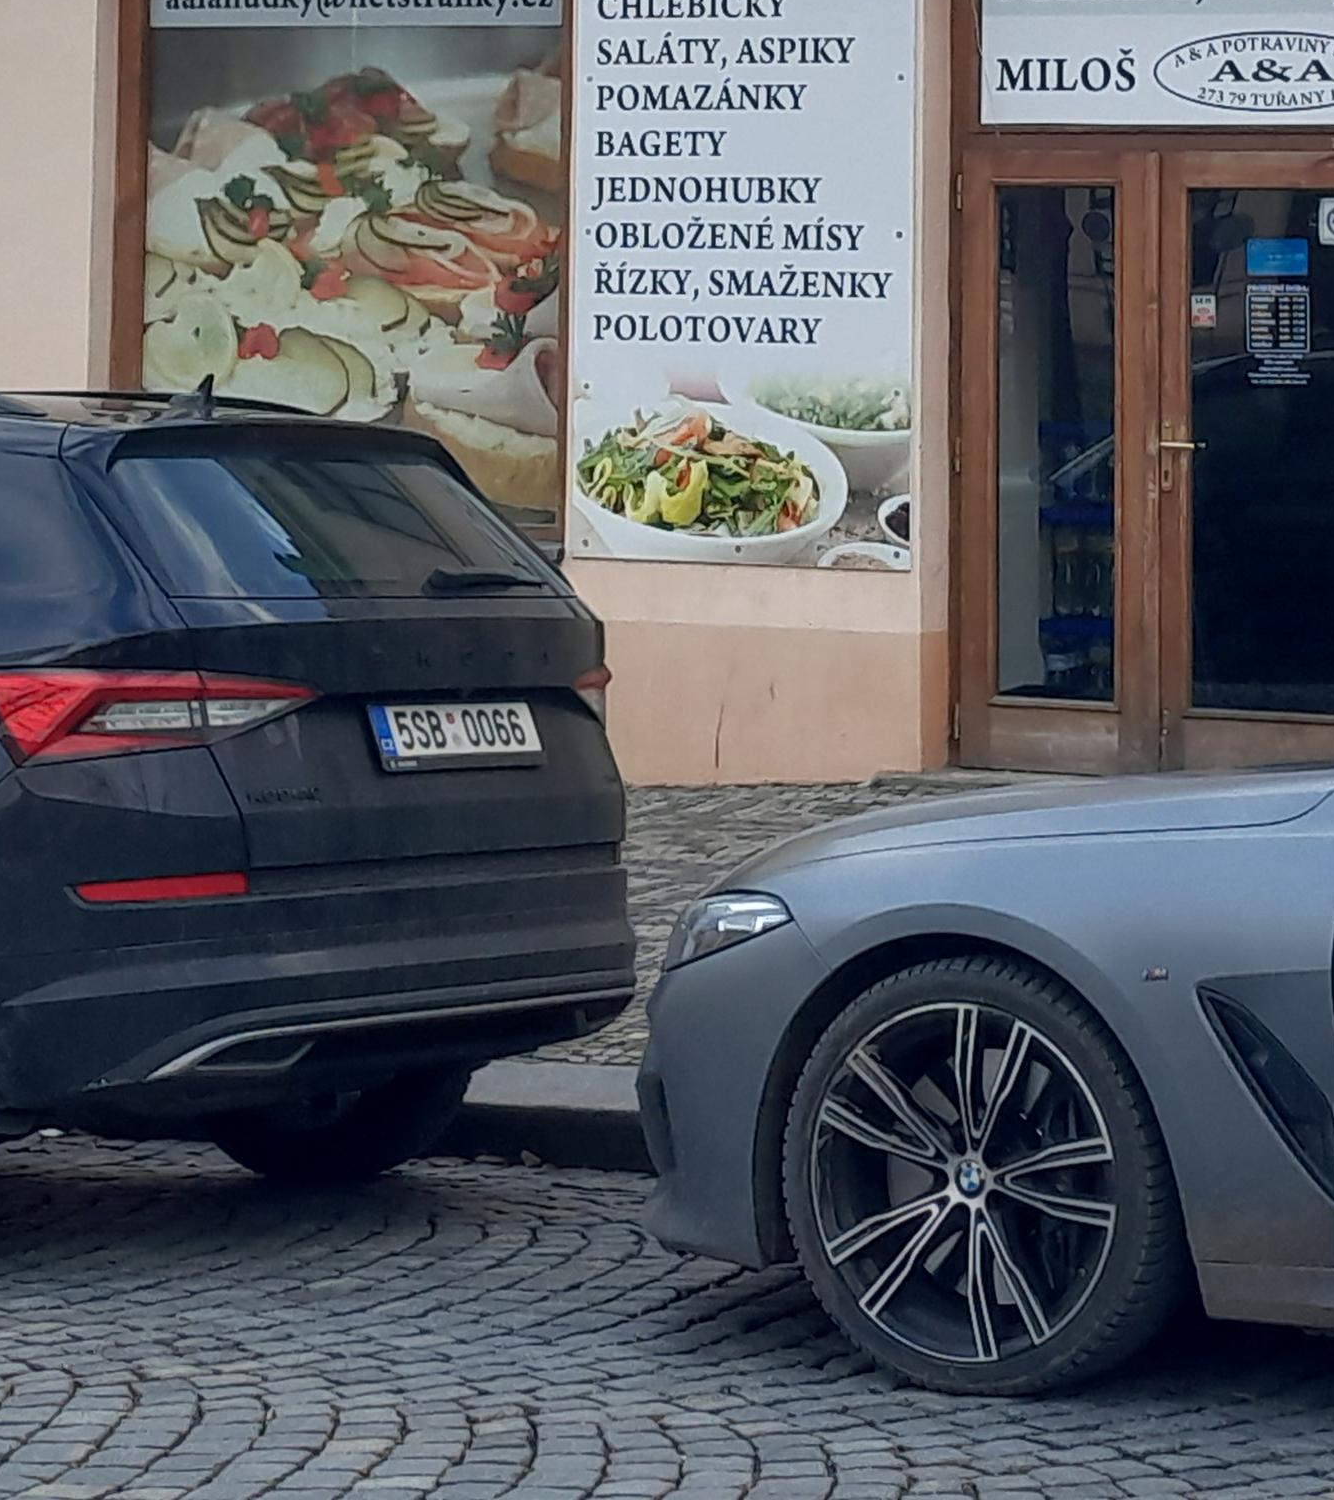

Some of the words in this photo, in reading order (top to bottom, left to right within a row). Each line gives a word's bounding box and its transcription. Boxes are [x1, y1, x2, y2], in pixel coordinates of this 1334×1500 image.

[596, 32, 728, 69] SALÁTY,
[736, 37, 856, 64] ASPIKY
[1174, 54, 1186, 68] A
[1189, 49, 1202, 62] &
[1206, 43, 1219, 56] A
[1223, 37, 1331, 54] POTRAVINY
[996, 48, 1136, 92] MILOŠ
[596, 77, 808, 111] POMAZÁNKY
[1197, 87, 1224, 103] 273
[1229, 92, 1247, 105] 79
[1250, 88, 1325, 107] TUŘANY
[595, 130, 727, 157] BAGETY
[592, 176, 822, 210] JEDNOHUBKY
[595, 216, 774, 250] OBLOŽENÉ
[782, 217, 864, 251] MÍSY
[594, 262, 700, 302] ŘÍZKY,
[708, 265, 894, 298] SMAŽENKY
[593, 315, 822, 345] POLOTOVARY
[393, 710, 447, 750] 5SB
[461, 708, 526, 747] 0066
